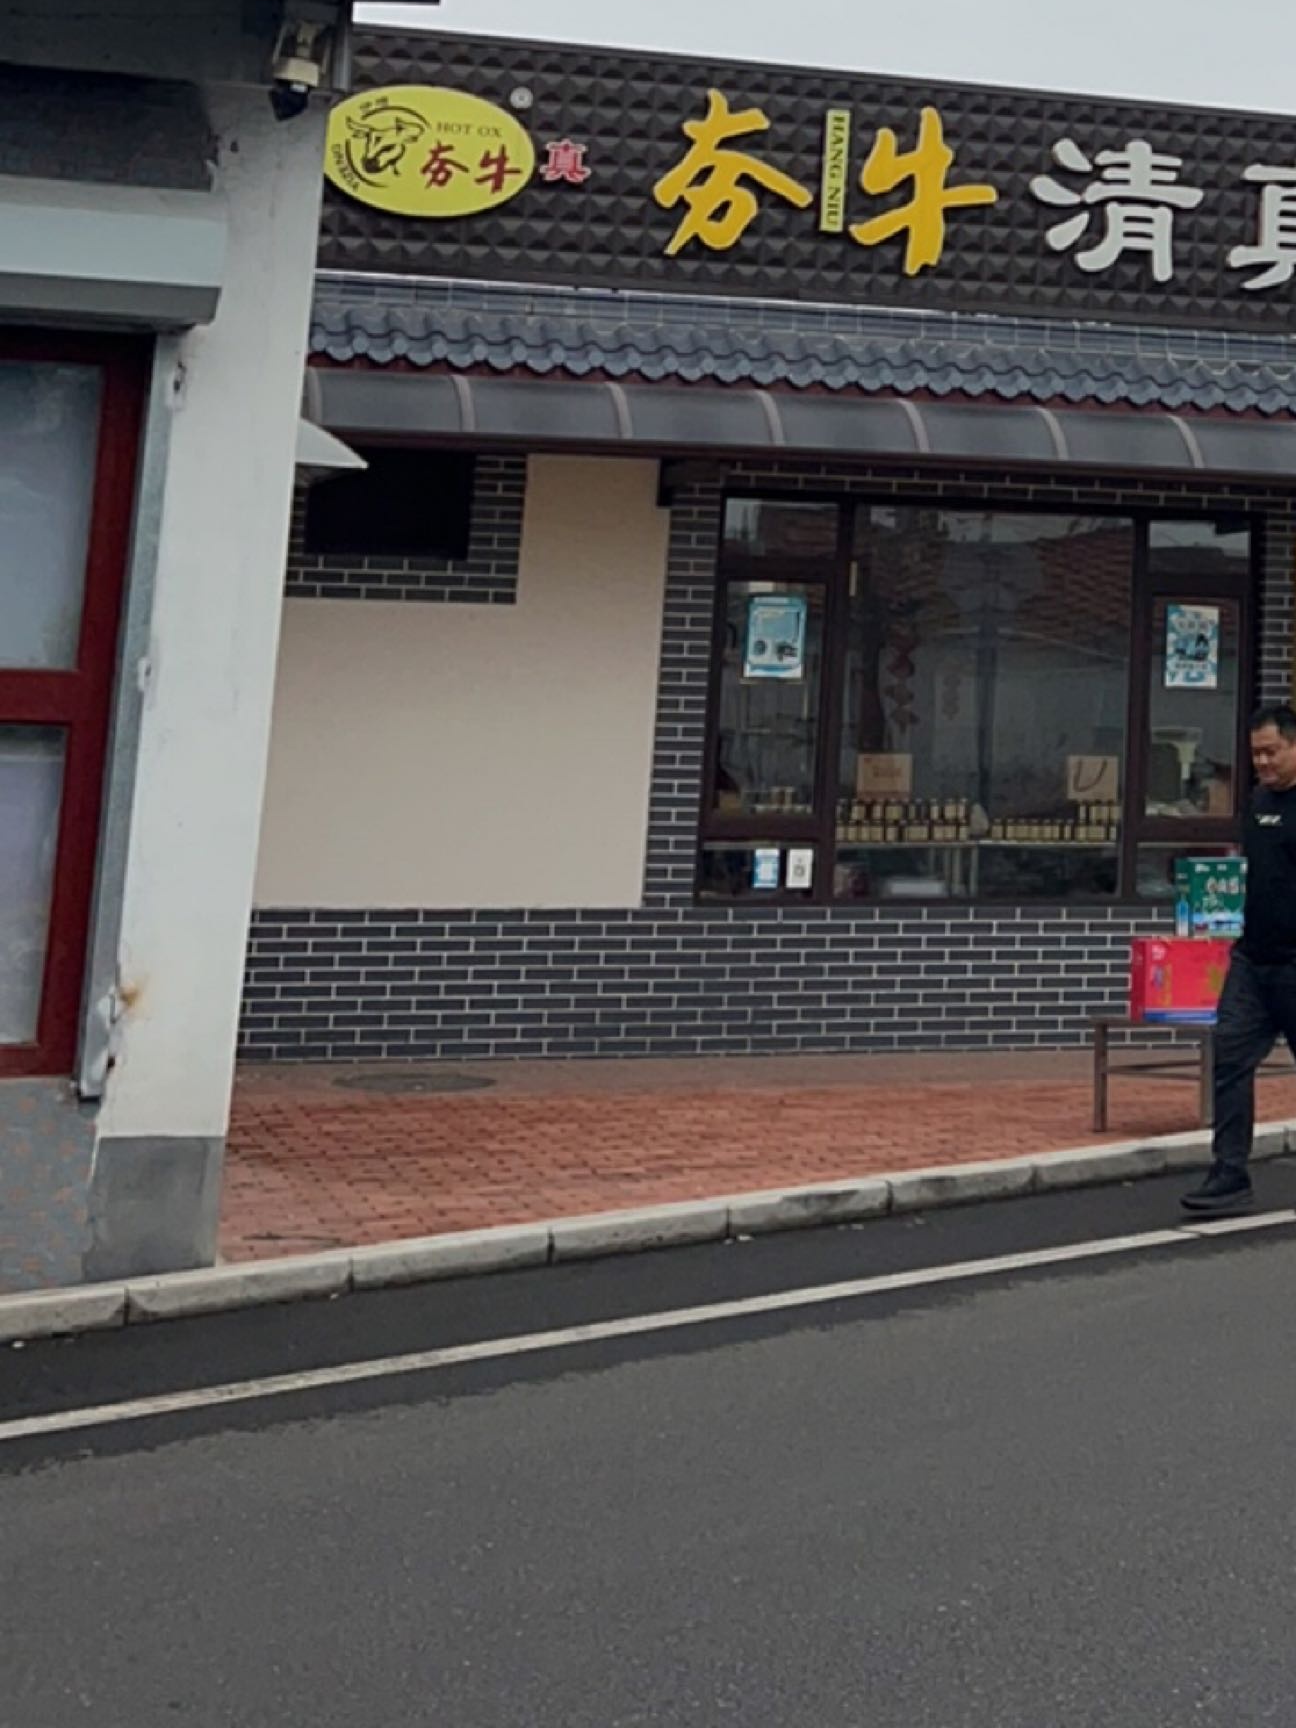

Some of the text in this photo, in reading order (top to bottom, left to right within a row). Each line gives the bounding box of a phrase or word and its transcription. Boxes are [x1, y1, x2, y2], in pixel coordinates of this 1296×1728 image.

[420, 141, 521, 194] 夯牛
[437, 122, 503, 139] HOT OX
[826, 116, 845, 225] HANG NIU
[653, 87, 997, 276] 夯牛
